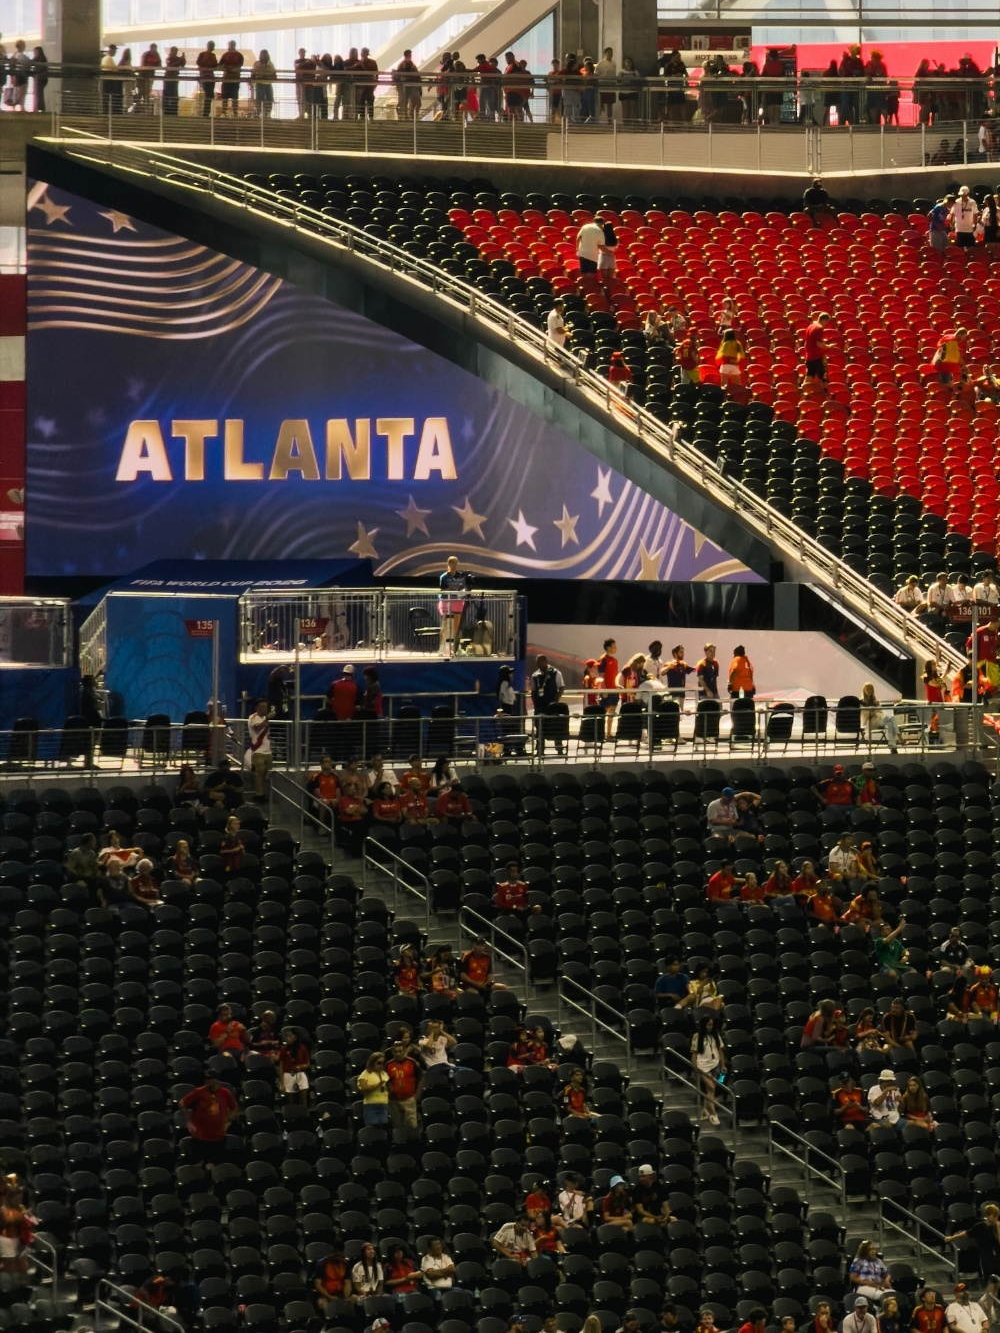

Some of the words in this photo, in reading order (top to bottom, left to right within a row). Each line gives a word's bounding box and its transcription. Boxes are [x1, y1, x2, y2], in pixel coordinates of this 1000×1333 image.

[115, 417, 457, 481] ATLANTA
[958, 606, 972, 616] 136
[979, 606, 992, 616] 101
[196, 620, 213, 630] 135
[300, 618, 316, 628] 136
